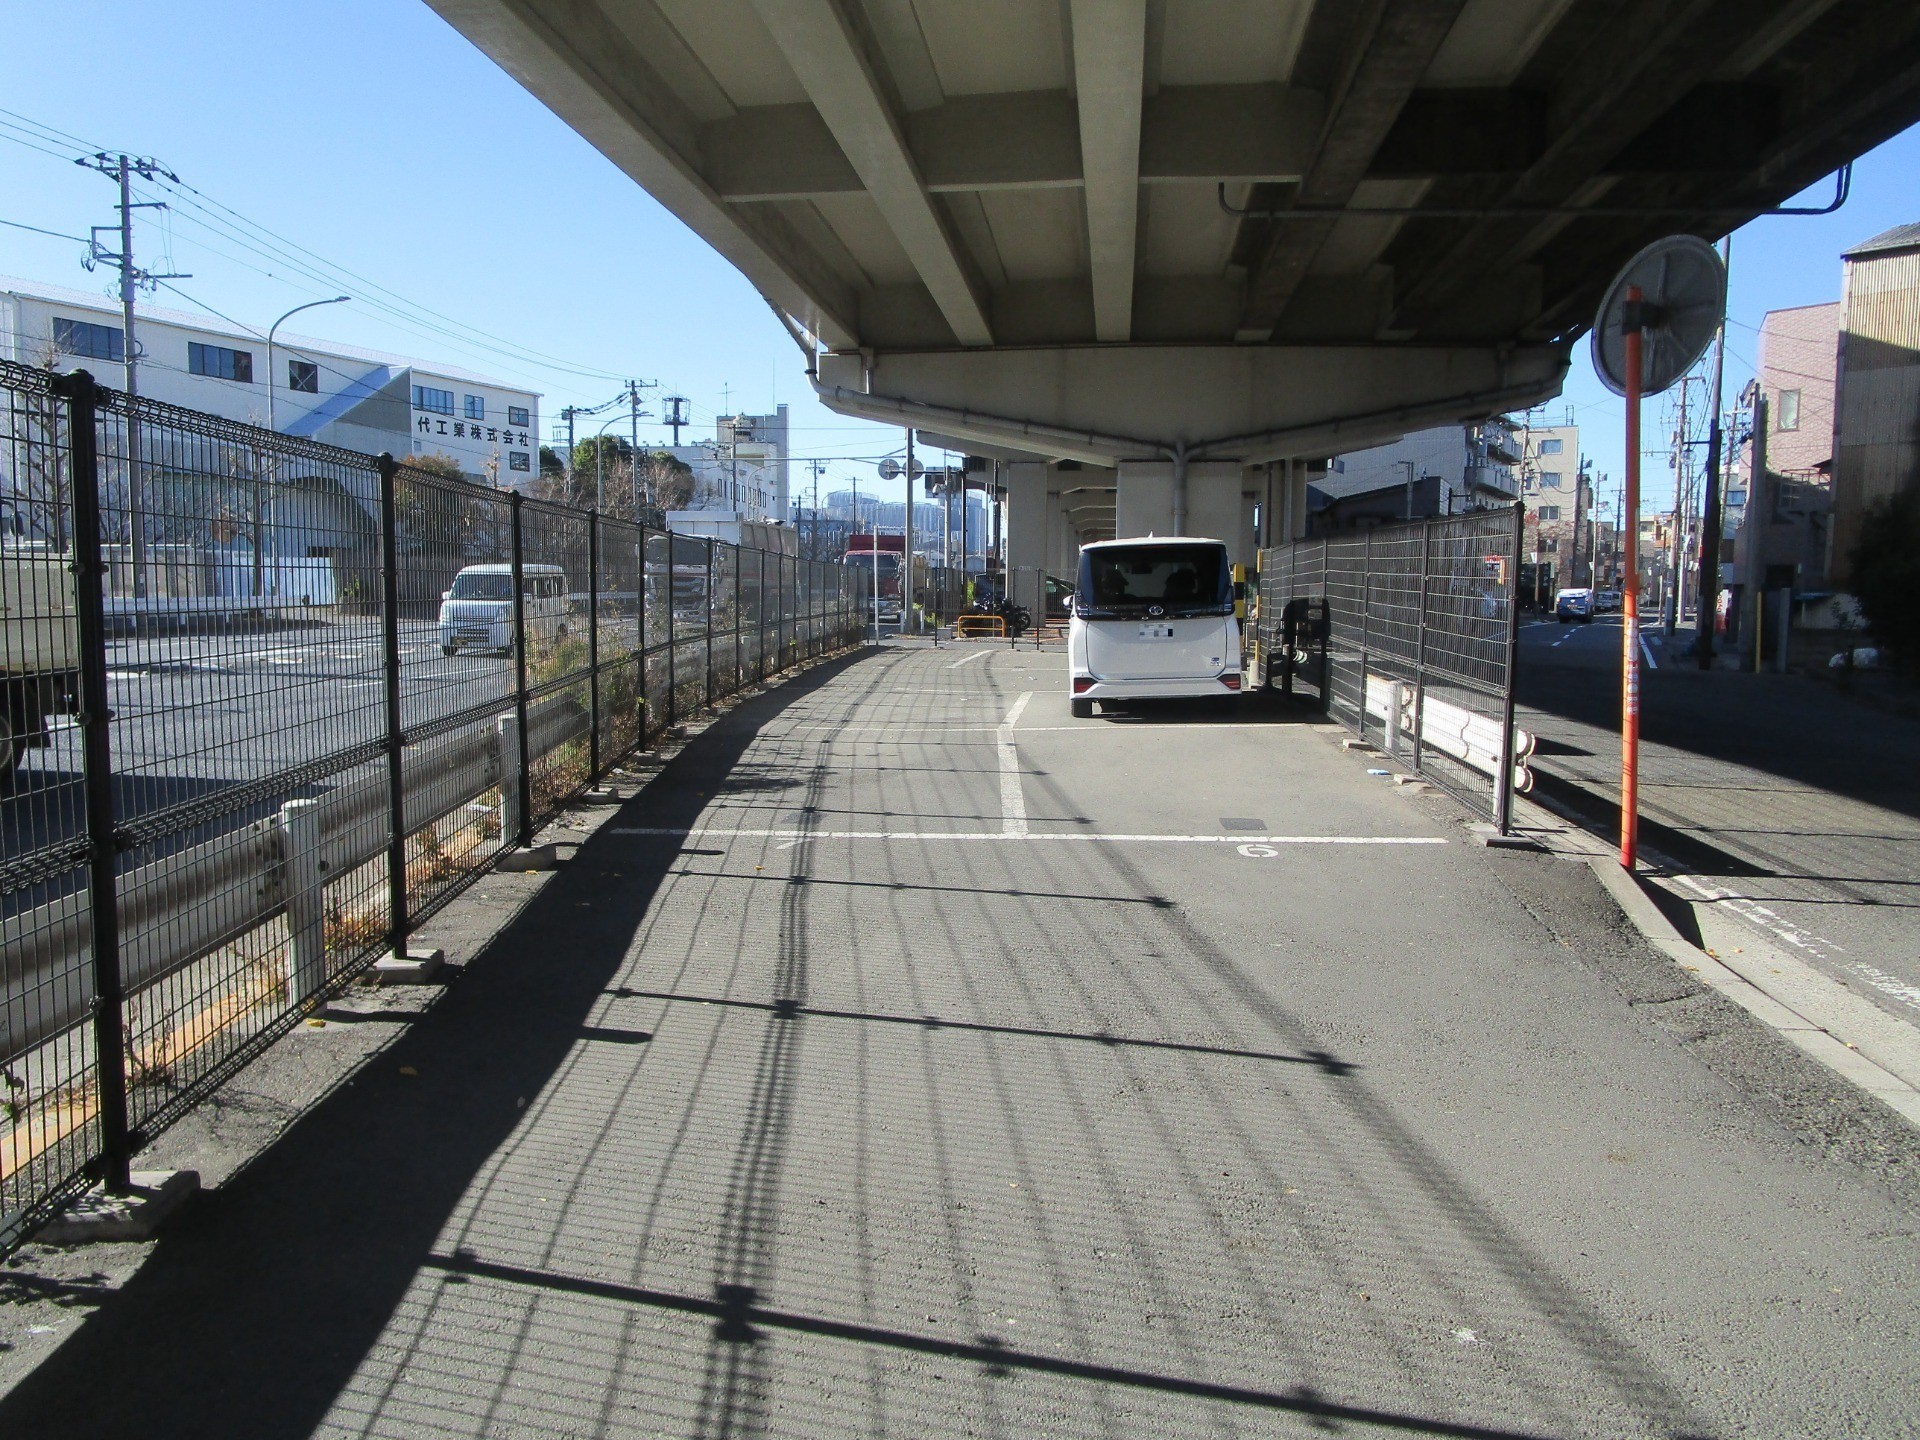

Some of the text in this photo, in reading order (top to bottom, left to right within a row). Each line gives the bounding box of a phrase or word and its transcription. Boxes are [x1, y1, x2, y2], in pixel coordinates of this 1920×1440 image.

[417, 416, 529, 447] 代工業株式会社
[1236, 843, 1279, 858] 6
